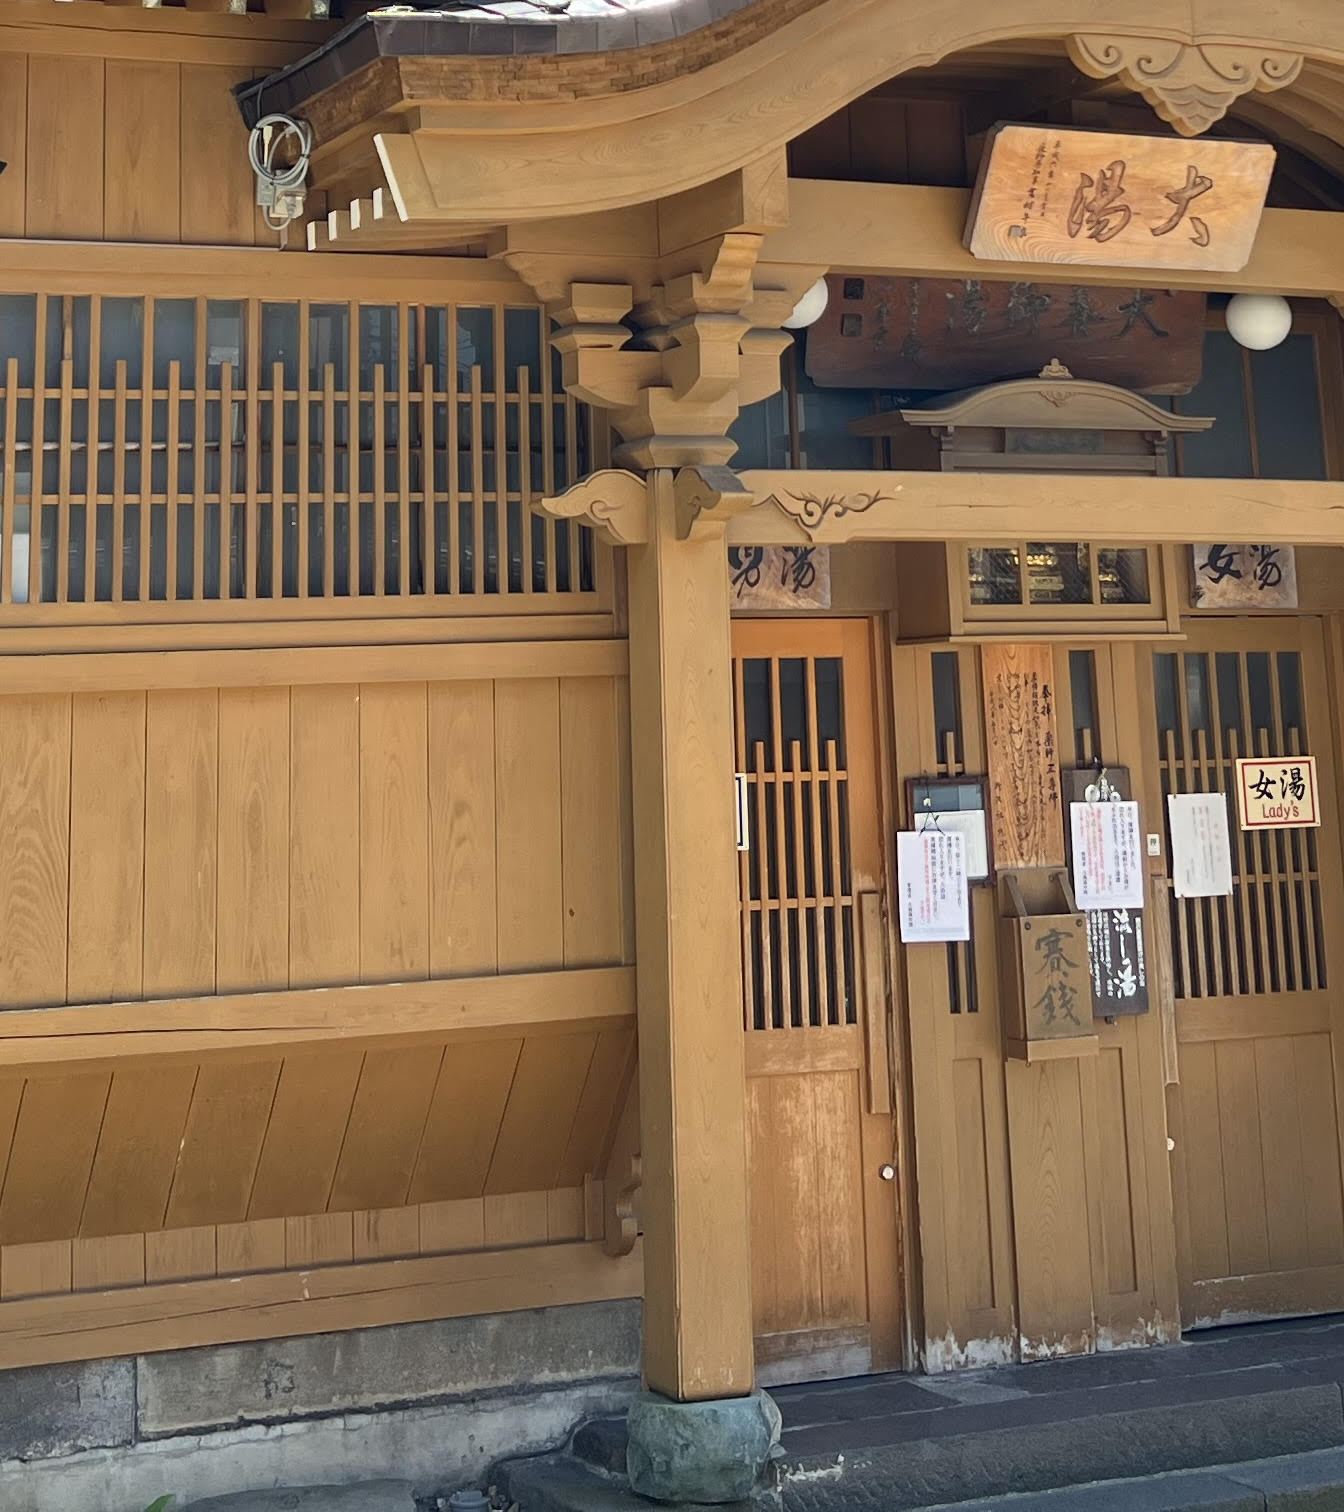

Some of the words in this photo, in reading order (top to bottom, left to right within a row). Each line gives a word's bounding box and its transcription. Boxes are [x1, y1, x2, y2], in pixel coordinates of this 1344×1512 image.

[1067, 159, 1213, 247] 大湯
[1248, 767, 1305, 801] 女湯
[1262, 800, 1300, 820] Lady's
